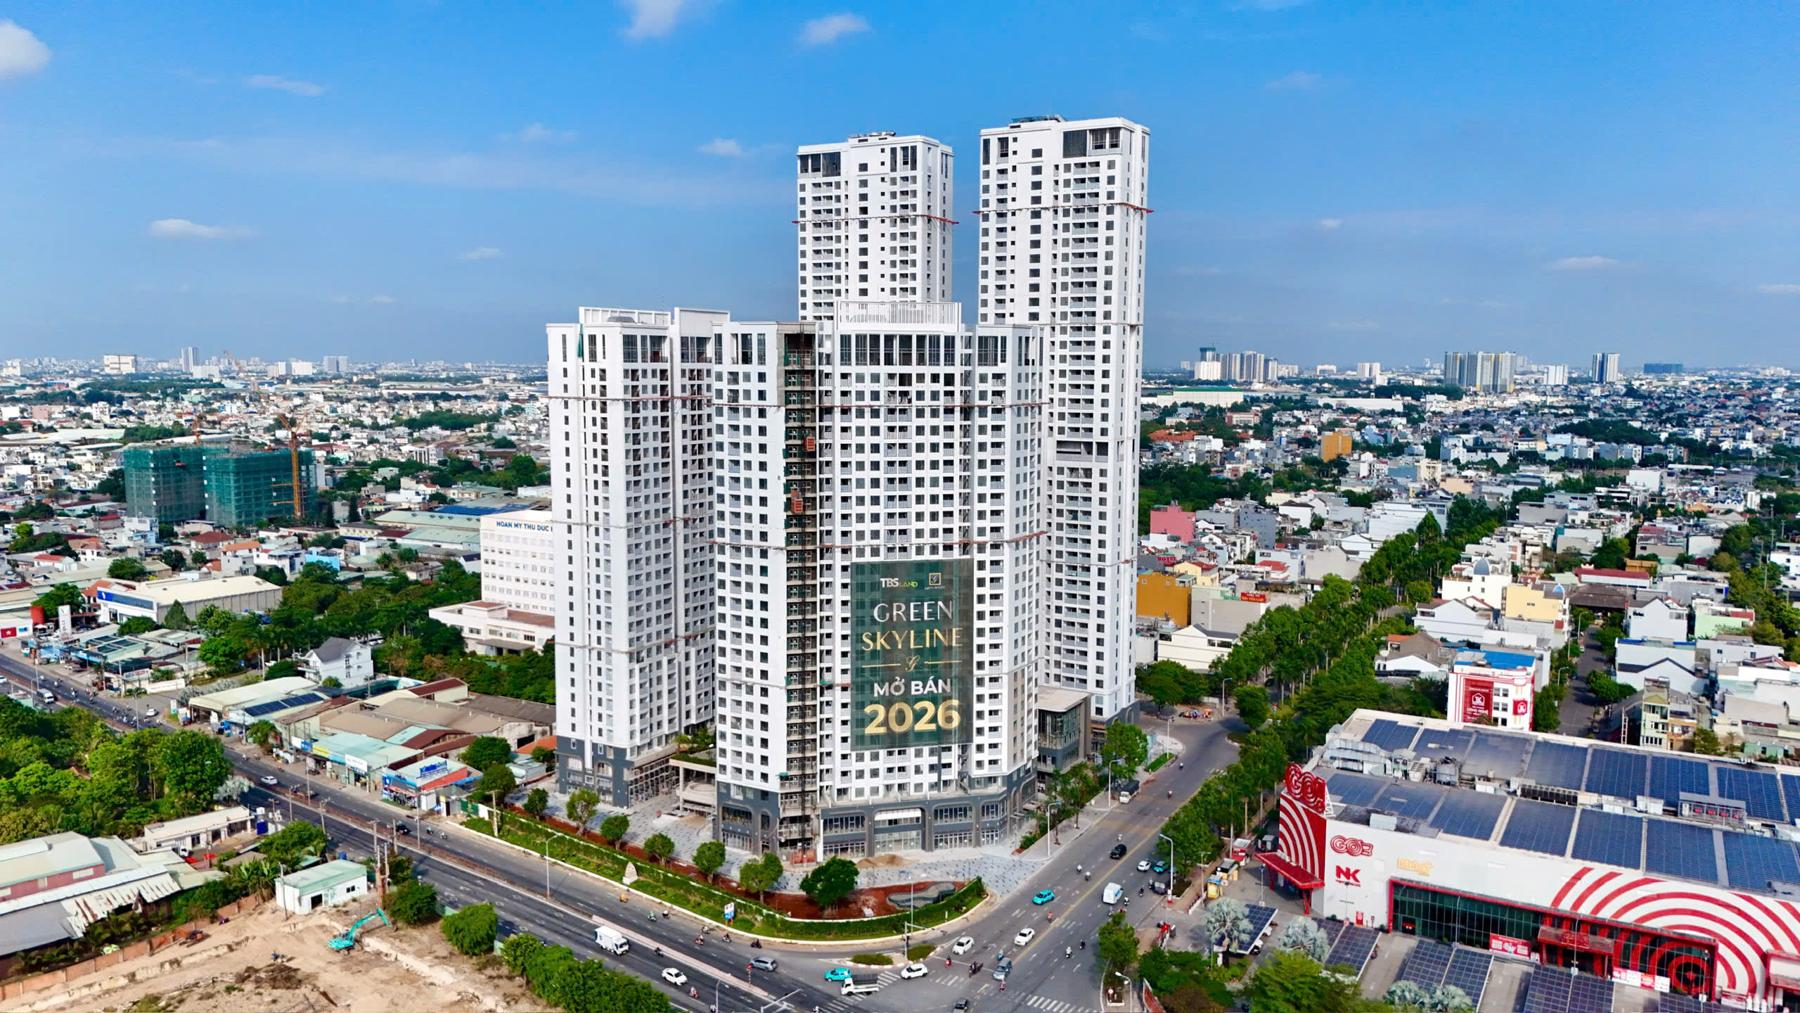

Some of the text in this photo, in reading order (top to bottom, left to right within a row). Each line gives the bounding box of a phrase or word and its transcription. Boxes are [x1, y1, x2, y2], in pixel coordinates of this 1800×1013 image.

[880, 577, 899, 588] TBS
[873, 600, 953, 623] GREEN
[862, 628, 963, 651] SKYLINE
[873, 675, 951, 697] MỞ BÁN
[863, 699, 961, 735] 2026
[1335, 865, 1361, 883] NK
